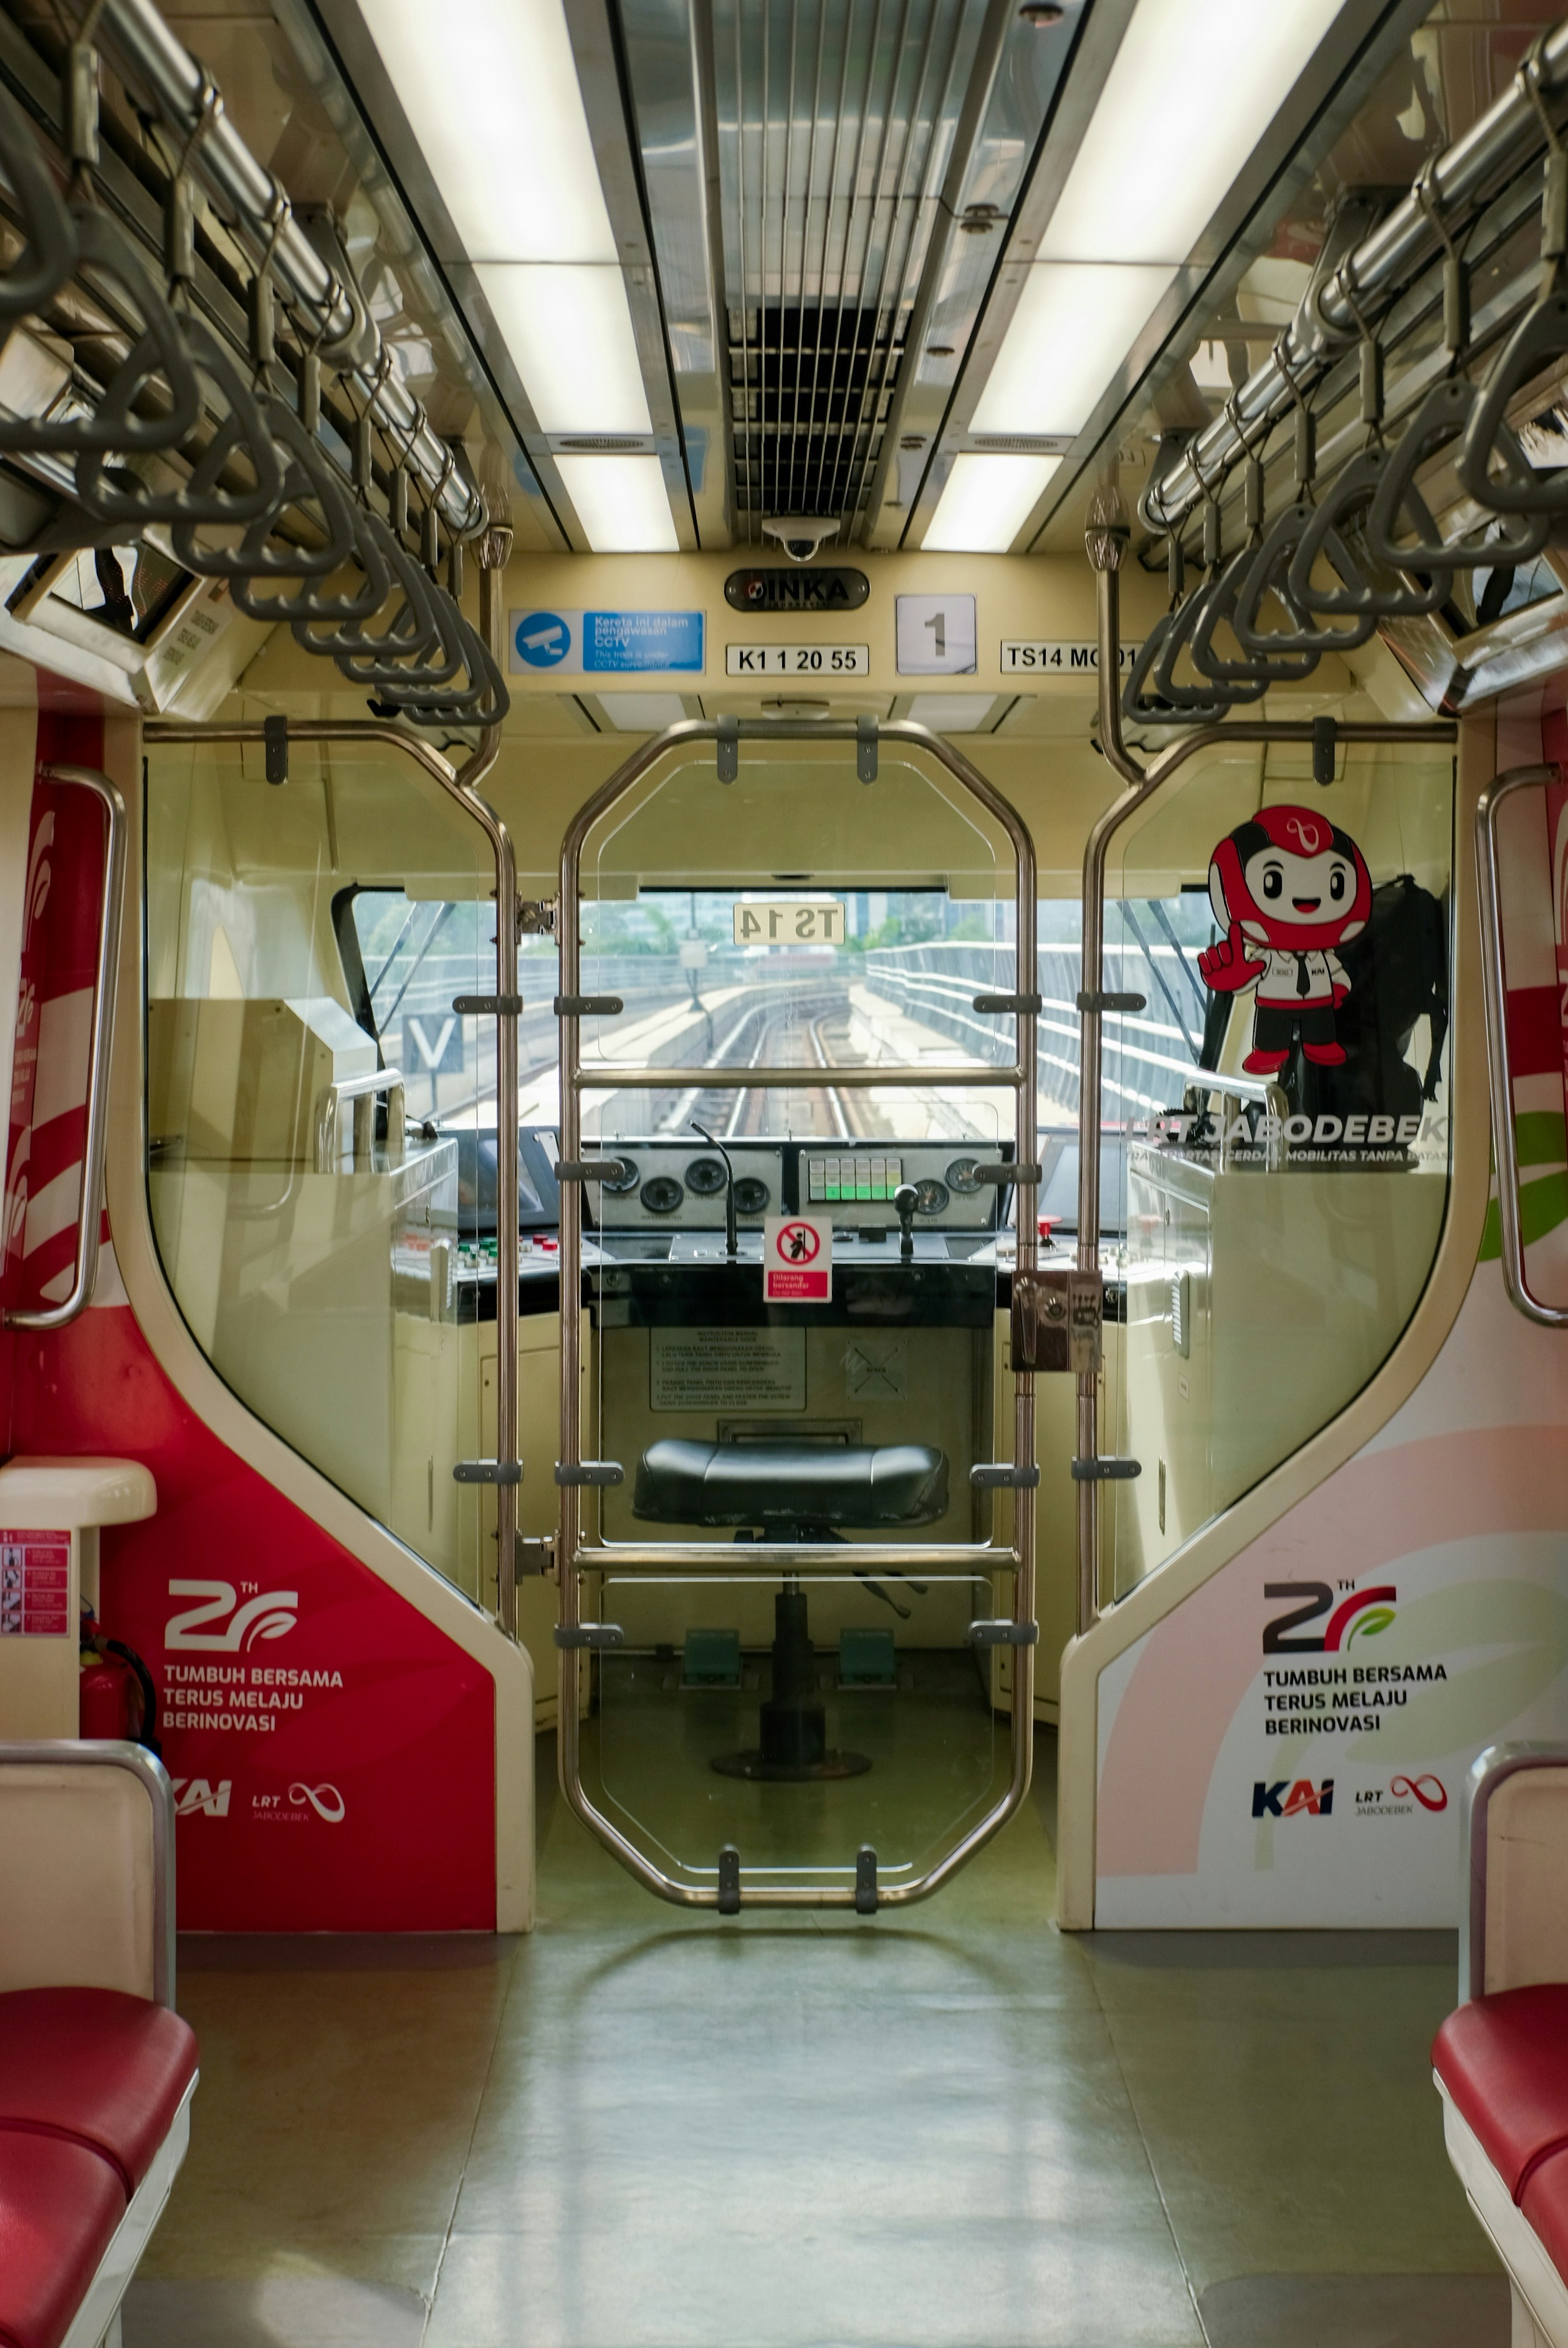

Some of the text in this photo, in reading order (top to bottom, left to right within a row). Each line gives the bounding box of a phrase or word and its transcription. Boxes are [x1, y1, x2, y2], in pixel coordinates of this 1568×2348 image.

[768, 578, 849, 600] INKA
[595, 616, 688, 627] Kereta ini dalam
[595, 626, 666, 637] pengawasan
[595, 637, 629, 648] CCTV
[924, 613, 945, 656] 1
[595, 659, 618, 668] CCTV
[596, 650, 611, 659] This
[739, 650, 856, 670] K1 1 20 55
[1007, 647, 1063, 667] TS14
[1203, 1114, 1448, 1143] JABODEBEK
[1286, 1150, 1356, 1162] MOBILITAS
[1360, 1150, 1403, 1162] TANPA
[773, 1273, 803, 1282] Dilarang
[164, 1665, 343, 1688] TUMBUH BERSAMA
[1263, 1664, 1447, 1688] TUMBUH BERSAMA
[164, 1689, 303, 1709] TERUS MELAJU
[1264, 1690, 1407, 1712] TERUS MELAJU
[163, 1712, 275, 1732] BERINOVASI
[1265, 1715, 1380, 1735] BERINOVASI
[252, 1795, 280, 1808] LRT
[1252, 1778, 1334, 1818] KAI
[1355, 1790, 1383, 1804] LRT
[252, 1811, 310, 1822] JABODEBEK
[1355, 1804, 1413, 1816] JABODEBEK
